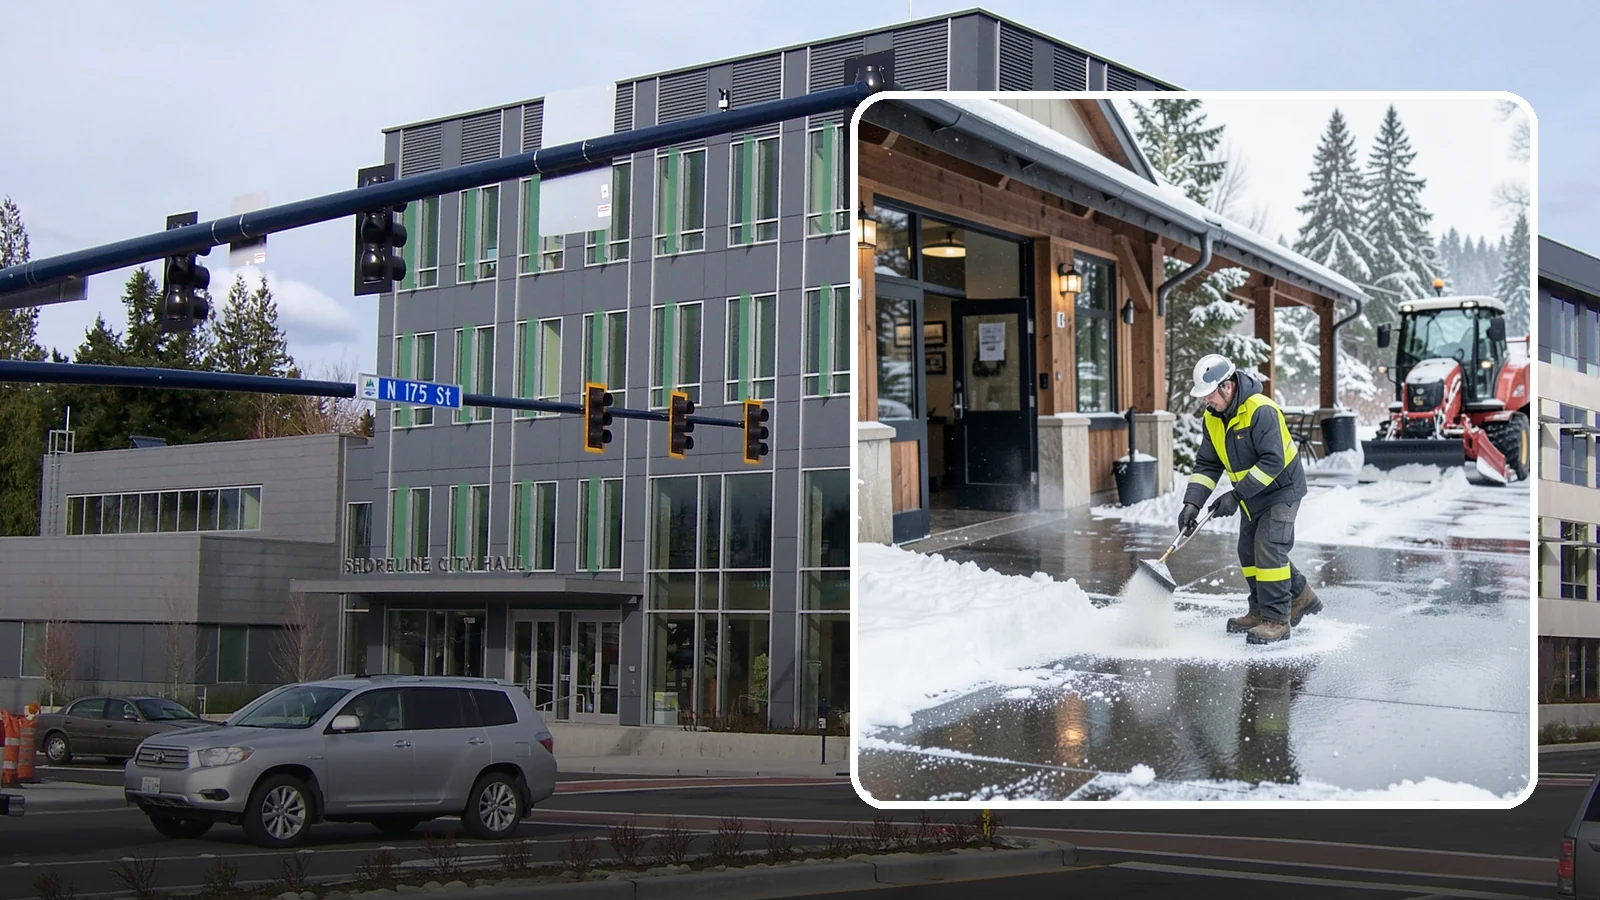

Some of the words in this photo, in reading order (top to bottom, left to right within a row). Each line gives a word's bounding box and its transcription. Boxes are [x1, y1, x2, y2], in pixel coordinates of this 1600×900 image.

[387, 381, 396, 400] N
[405, 383, 427, 403] 175
[436, 387, 451, 406] St
[344, 557, 431, 574] SHORELINE
[439, 556, 474, 572] CITY
[484, 555, 525, 571] HALL
